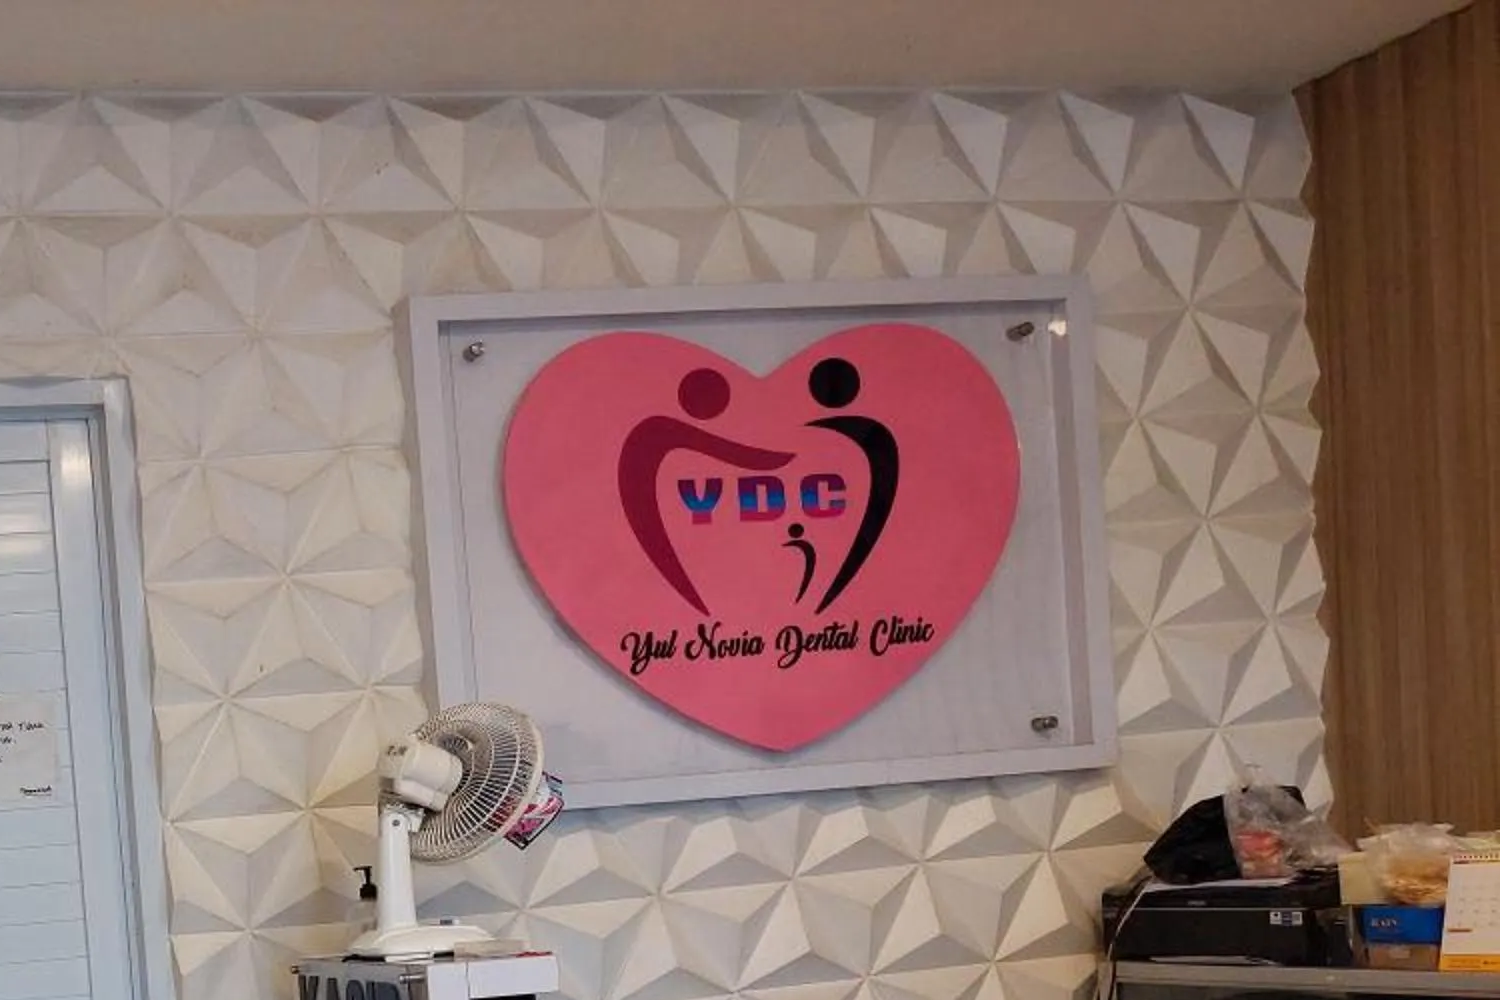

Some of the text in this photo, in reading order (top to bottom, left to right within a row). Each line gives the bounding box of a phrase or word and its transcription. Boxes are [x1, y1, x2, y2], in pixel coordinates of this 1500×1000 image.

[677, 474, 847, 525] YDC
[620, 616, 935, 675] Yul Novia Dental Clinic
